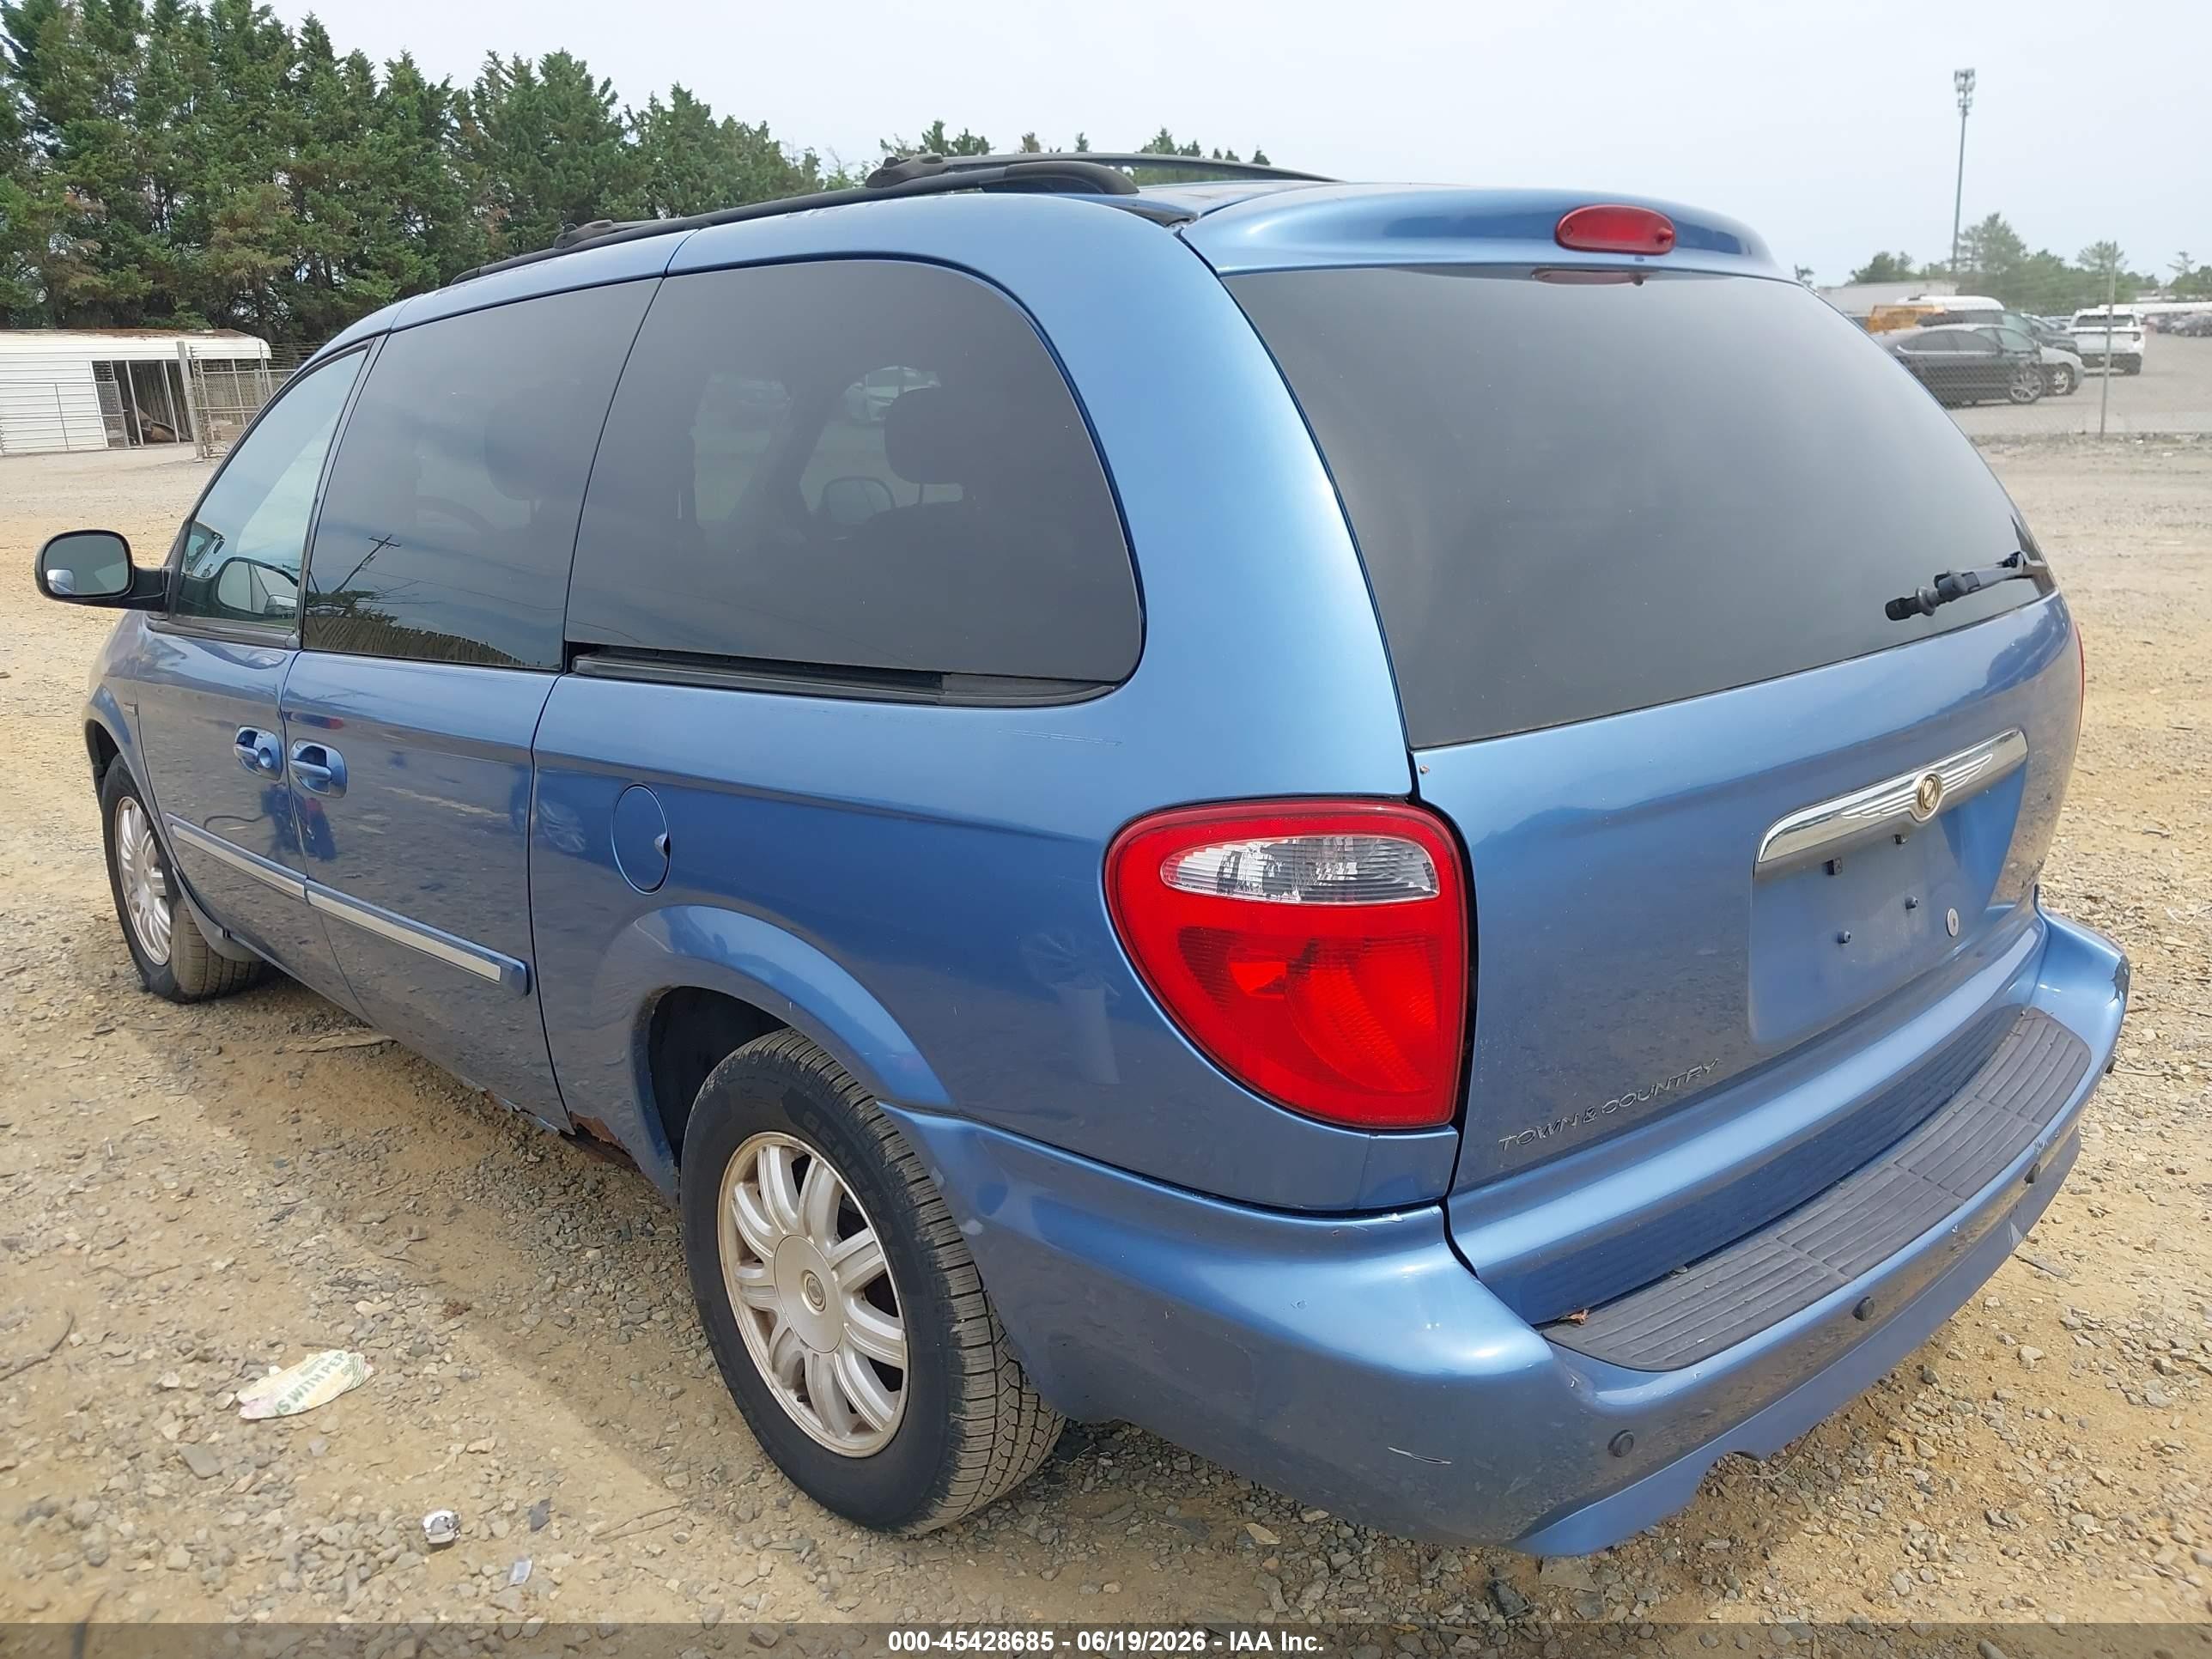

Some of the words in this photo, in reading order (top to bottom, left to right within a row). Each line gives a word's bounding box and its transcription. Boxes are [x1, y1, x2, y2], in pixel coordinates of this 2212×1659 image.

[1498, 1112, 1580, 1152] TOWN
[1582, 1106, 1598, 1124] &
[1601, 1057, 1722, 1115] COUNTRY
[288, 1374, 326, 1403] WITH
